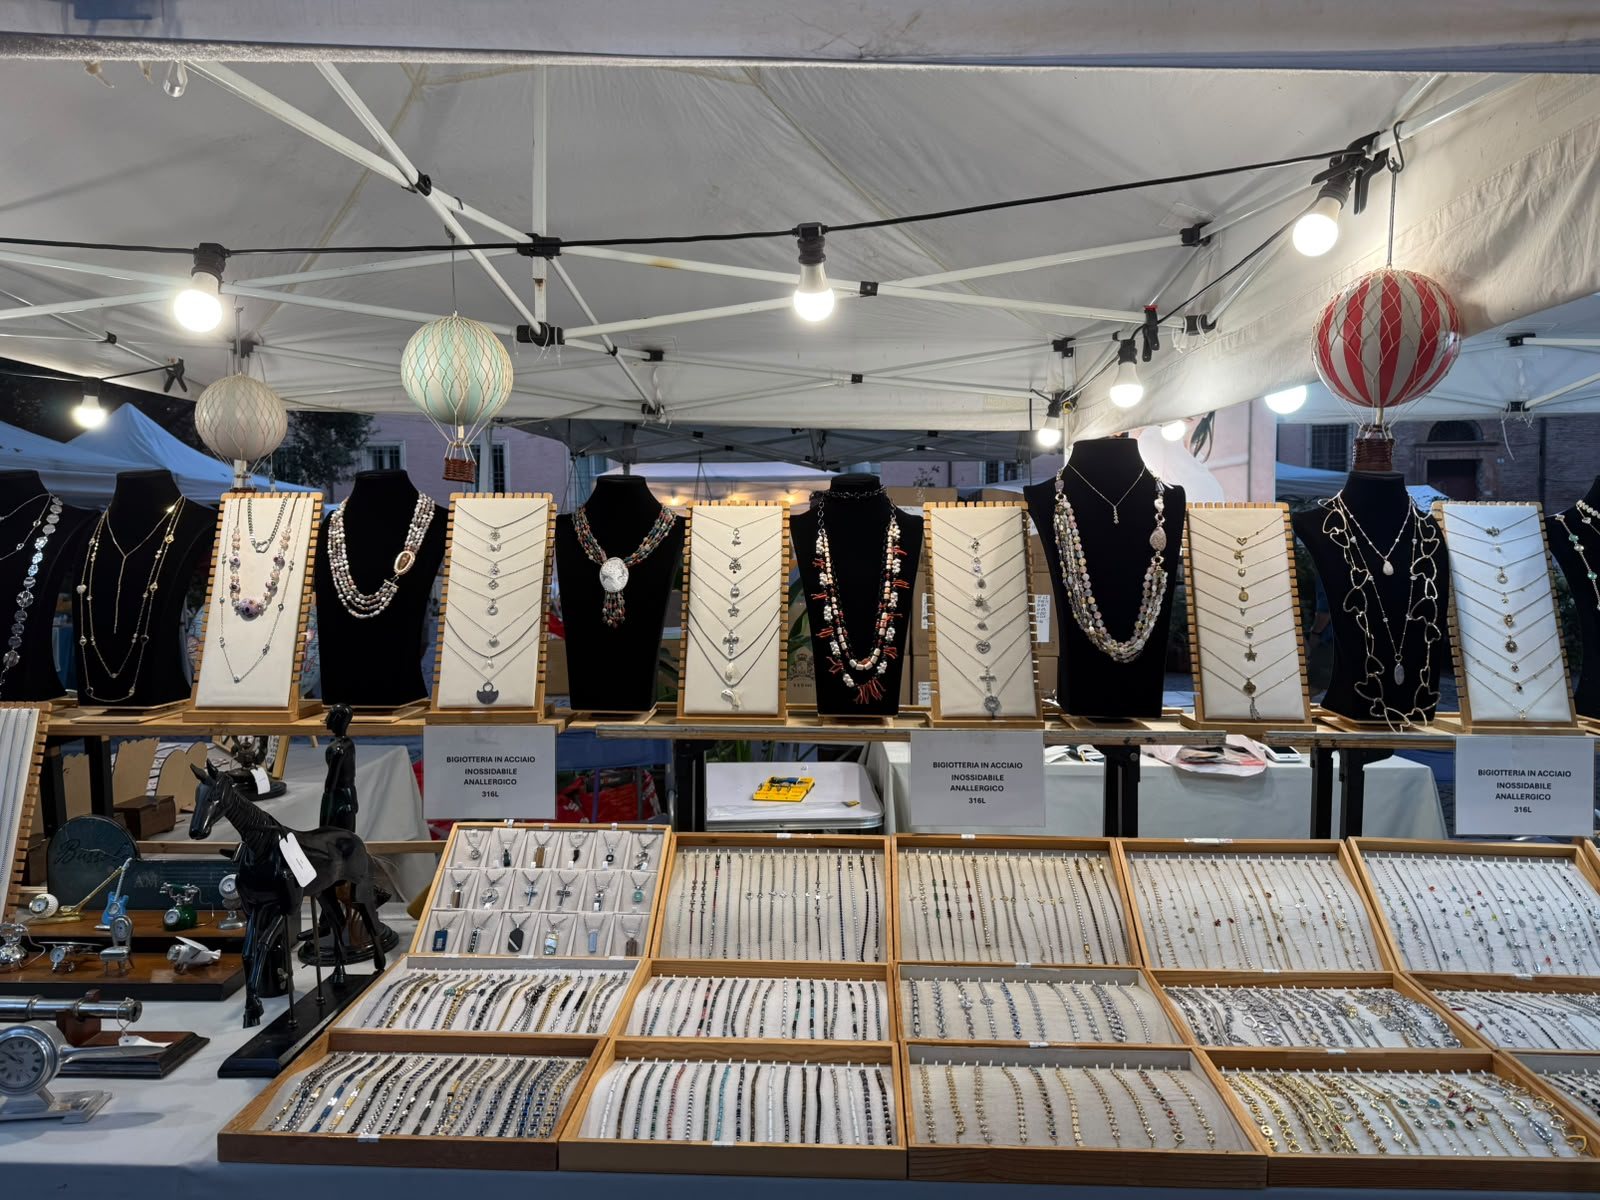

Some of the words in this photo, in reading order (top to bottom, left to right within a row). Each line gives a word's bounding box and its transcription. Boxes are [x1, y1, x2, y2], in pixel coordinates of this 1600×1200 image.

[446, 755, 493, 764] BIGIOTTERIA
[494, 755, 503, 764] IN
[504, 755, 536, 764] ACCIAIO
[932, 761, 979, 769] BIGIOTTERIA
[980, 761, 989, 769] IN
[990, 761, 1023, 769] ACCIAIO
[464, 767, 518, 776] INOSSIDABILE
[1477, 768, 1526, 778] BIGIOTTERIA
[1527, 768, 1536, 778] IN
[1537, 768, 1572, 778] ACCIAIO
[951, 773, 1005, 782] INOSSIDABILE
[463, 778, 518, 787] ANALLERGICO
[1496, 781, 1552, 790] INOSSIDABILE
[950, 784, 1005, 793] ANALLERGICO
[481, 790, 500, 799] 316L
[1495, 792, 1552, 802] ANALLERGICO
[968, 796, 986, 805] 316L
[1513, 805, 1533, 815] 316L
